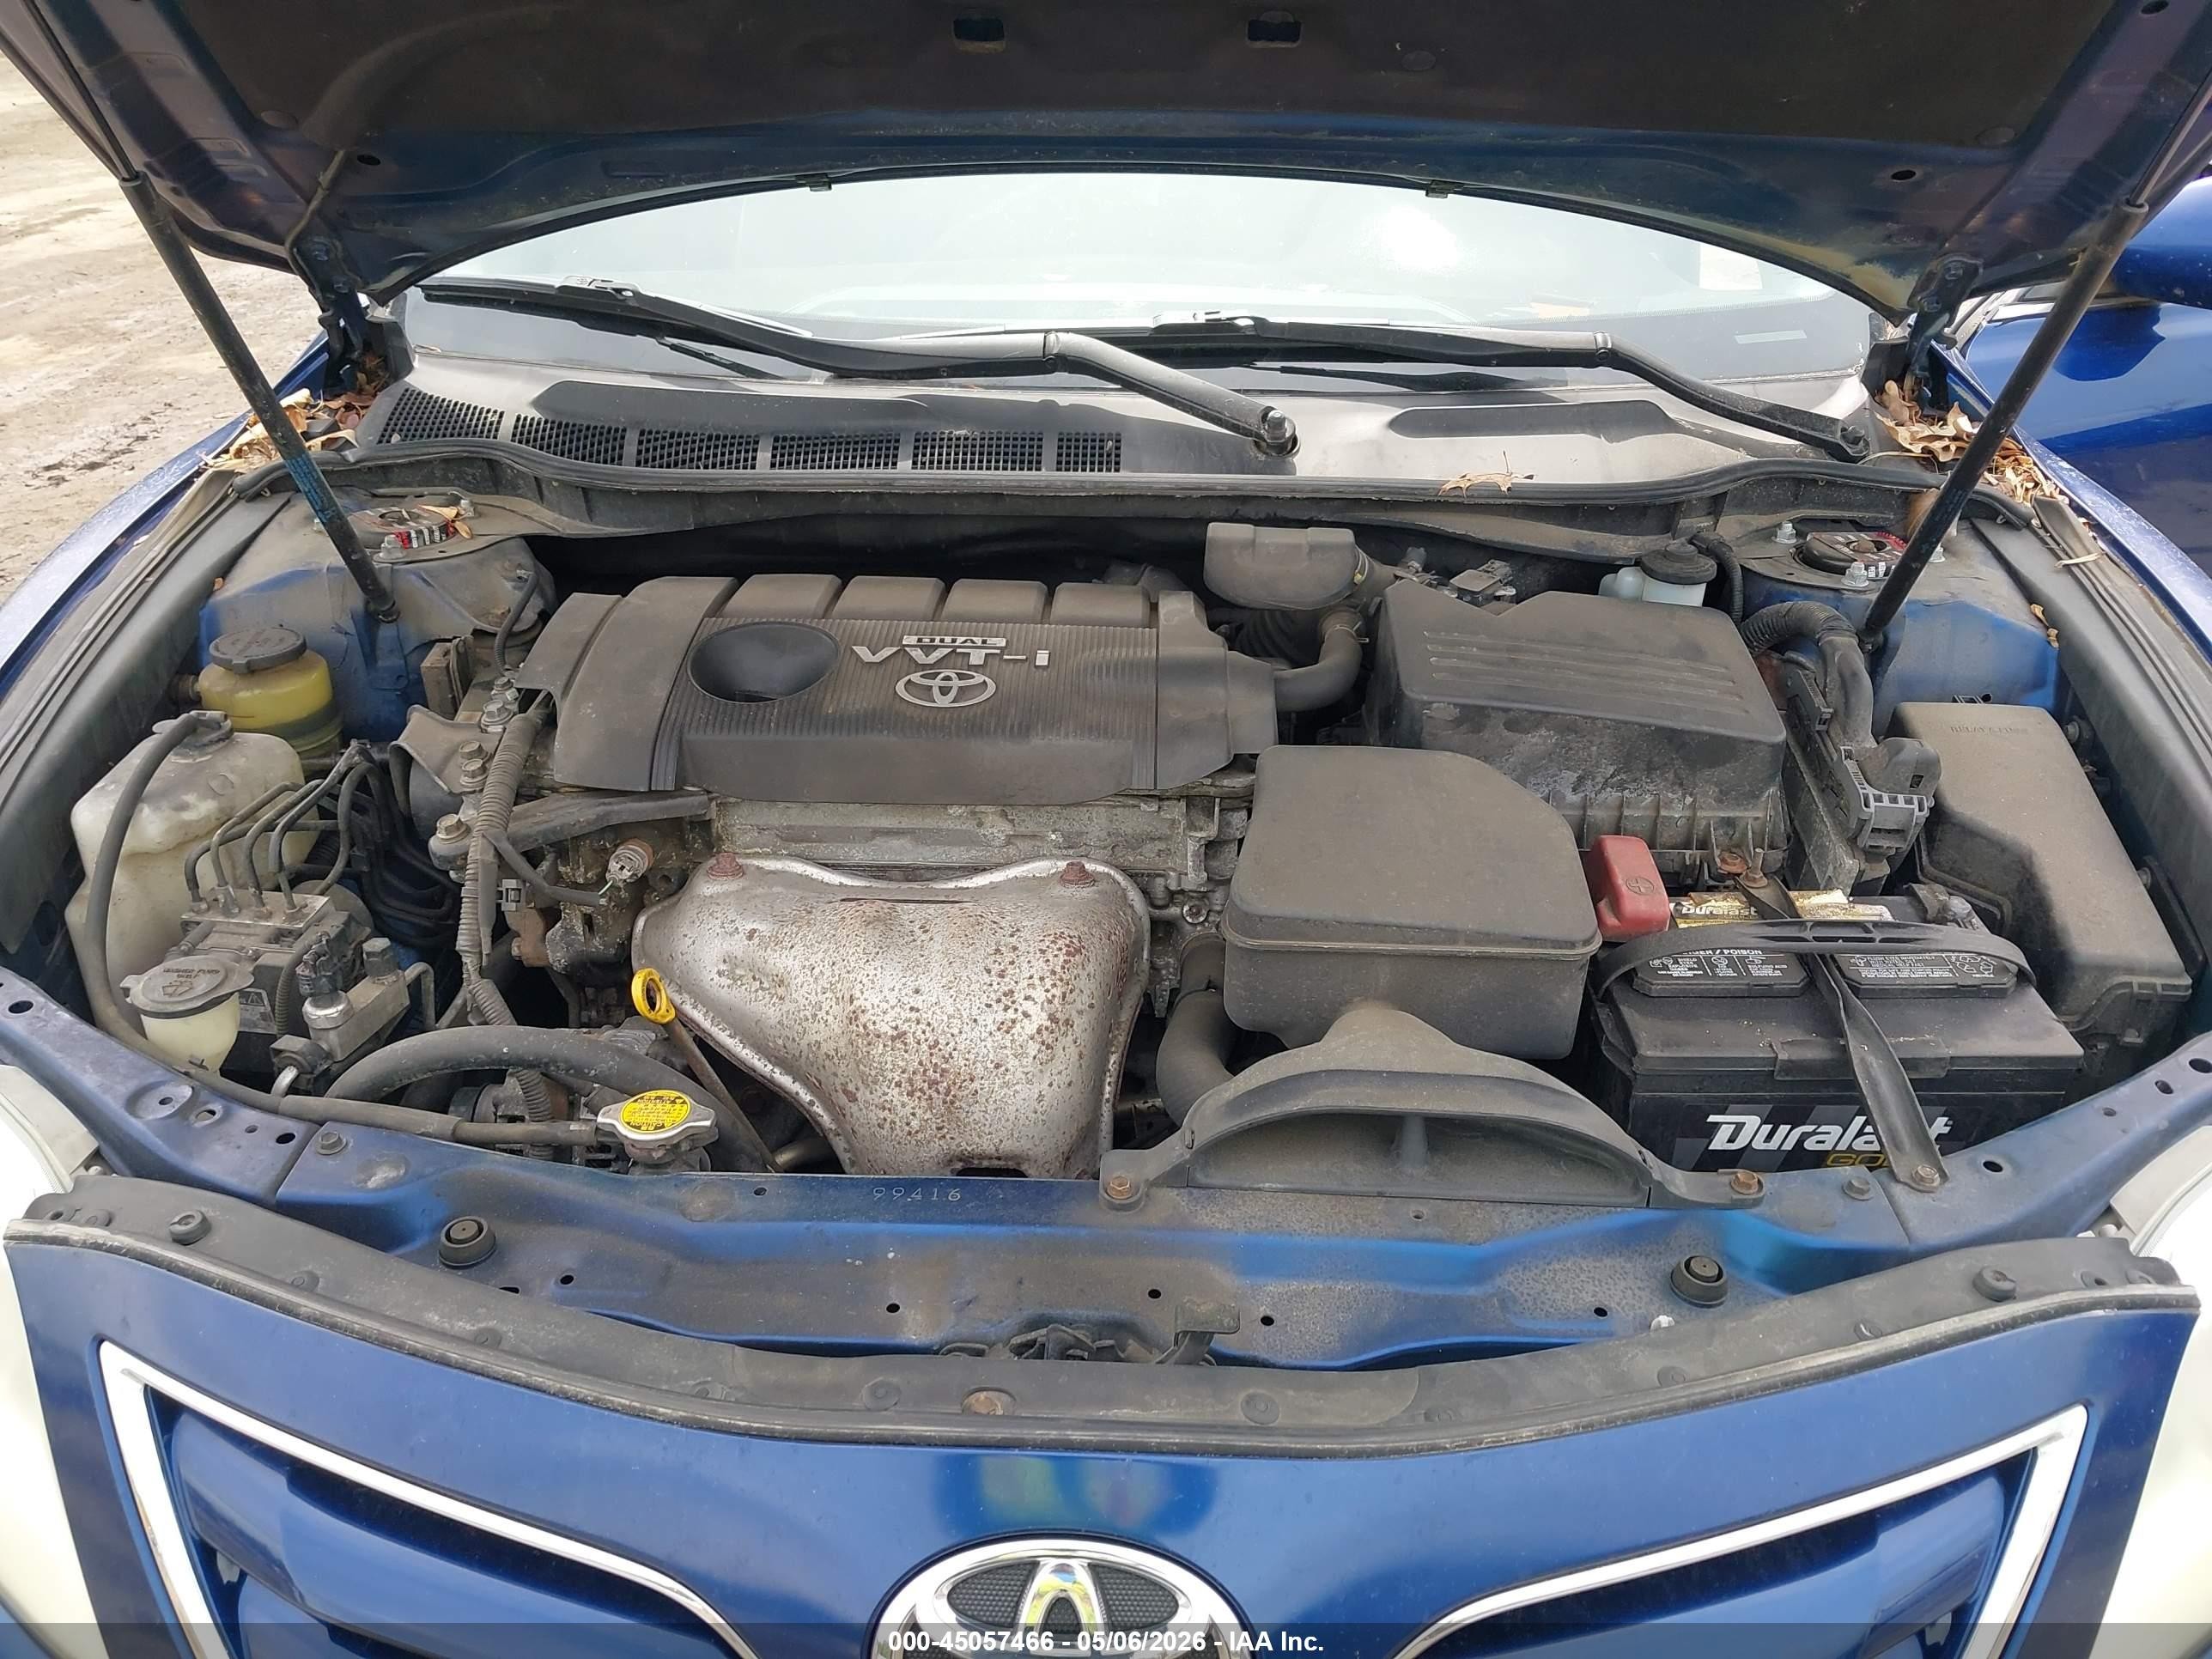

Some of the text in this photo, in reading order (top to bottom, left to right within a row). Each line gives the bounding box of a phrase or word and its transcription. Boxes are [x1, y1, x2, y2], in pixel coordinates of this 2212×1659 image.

[915, 636, 998, 645] DUAL
[851, 646, 1050, 666] VVT-i
[1706, 1115, 1954, 1151] Duralat
[872, 1188, 961, 1201] 99416
